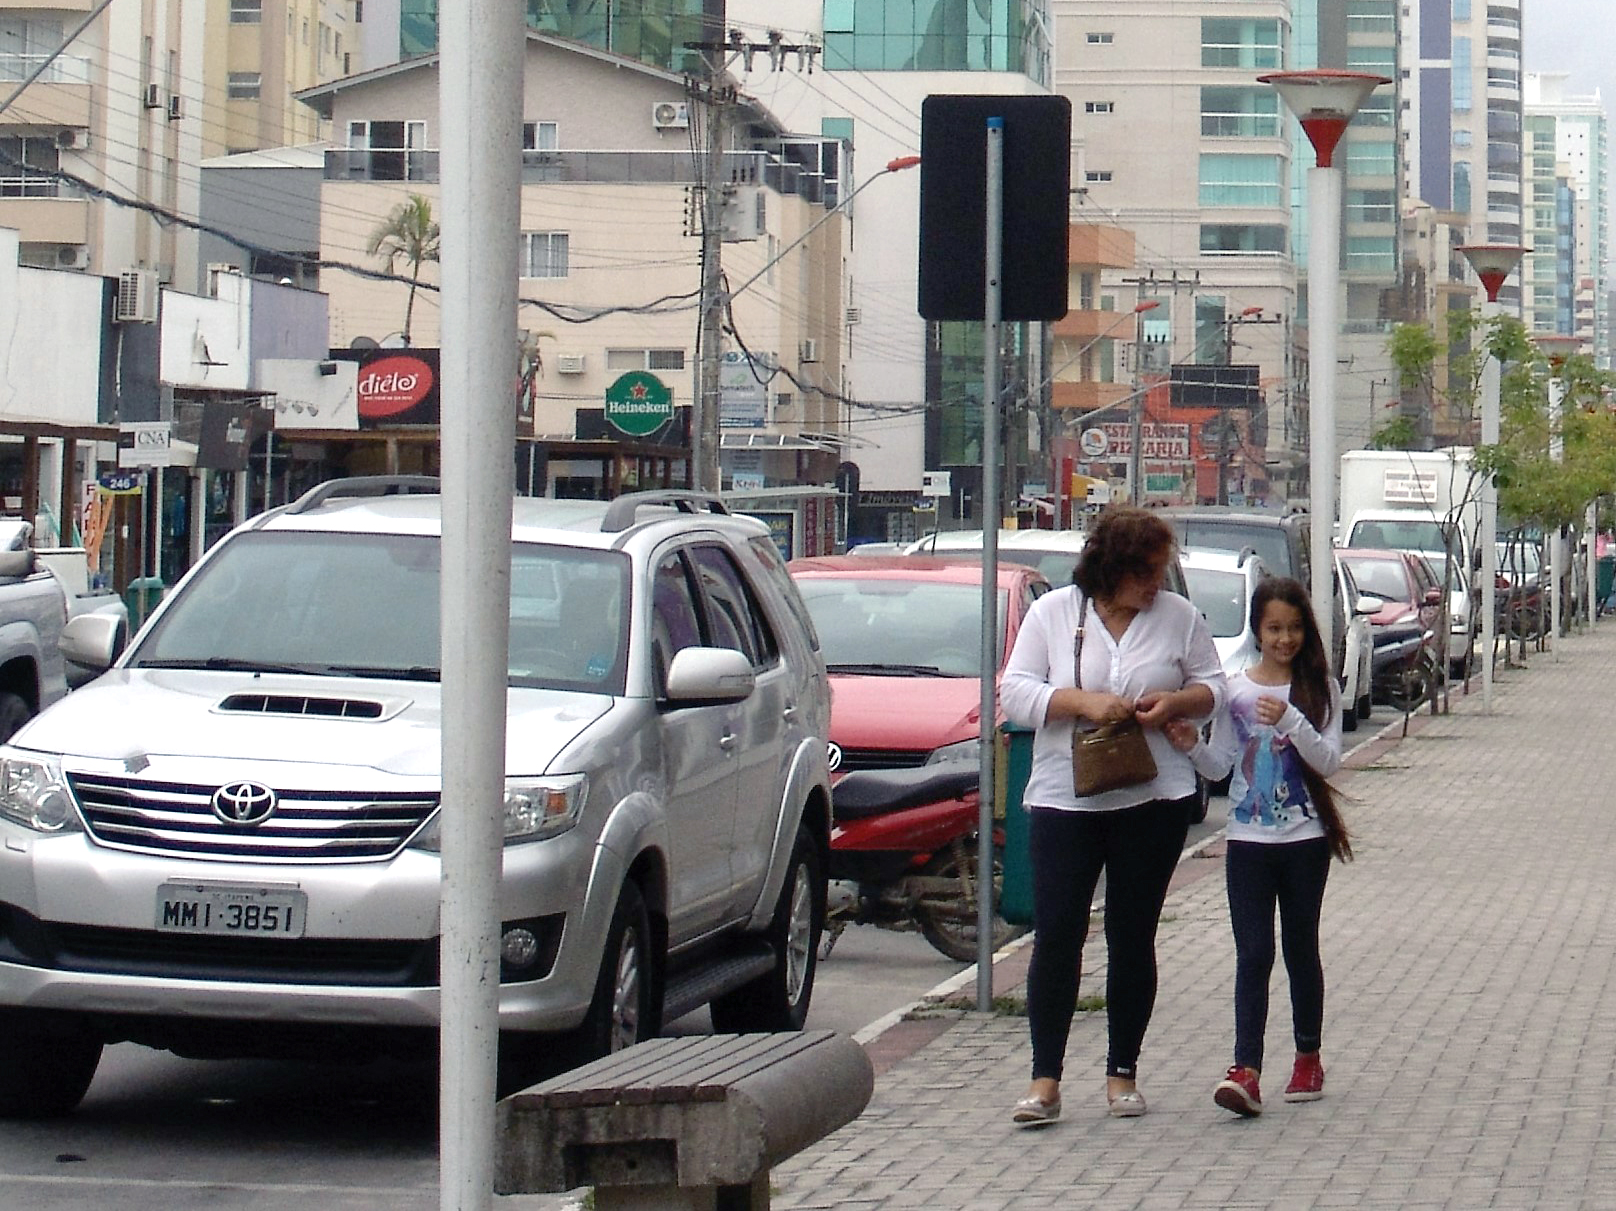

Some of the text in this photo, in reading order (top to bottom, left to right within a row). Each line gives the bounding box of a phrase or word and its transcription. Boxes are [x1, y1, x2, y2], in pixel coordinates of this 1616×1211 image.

[609, 401, 669, 413] Heineken
[138, 429, 165, 446] CNA
[110, 478, 130, 489] 246
